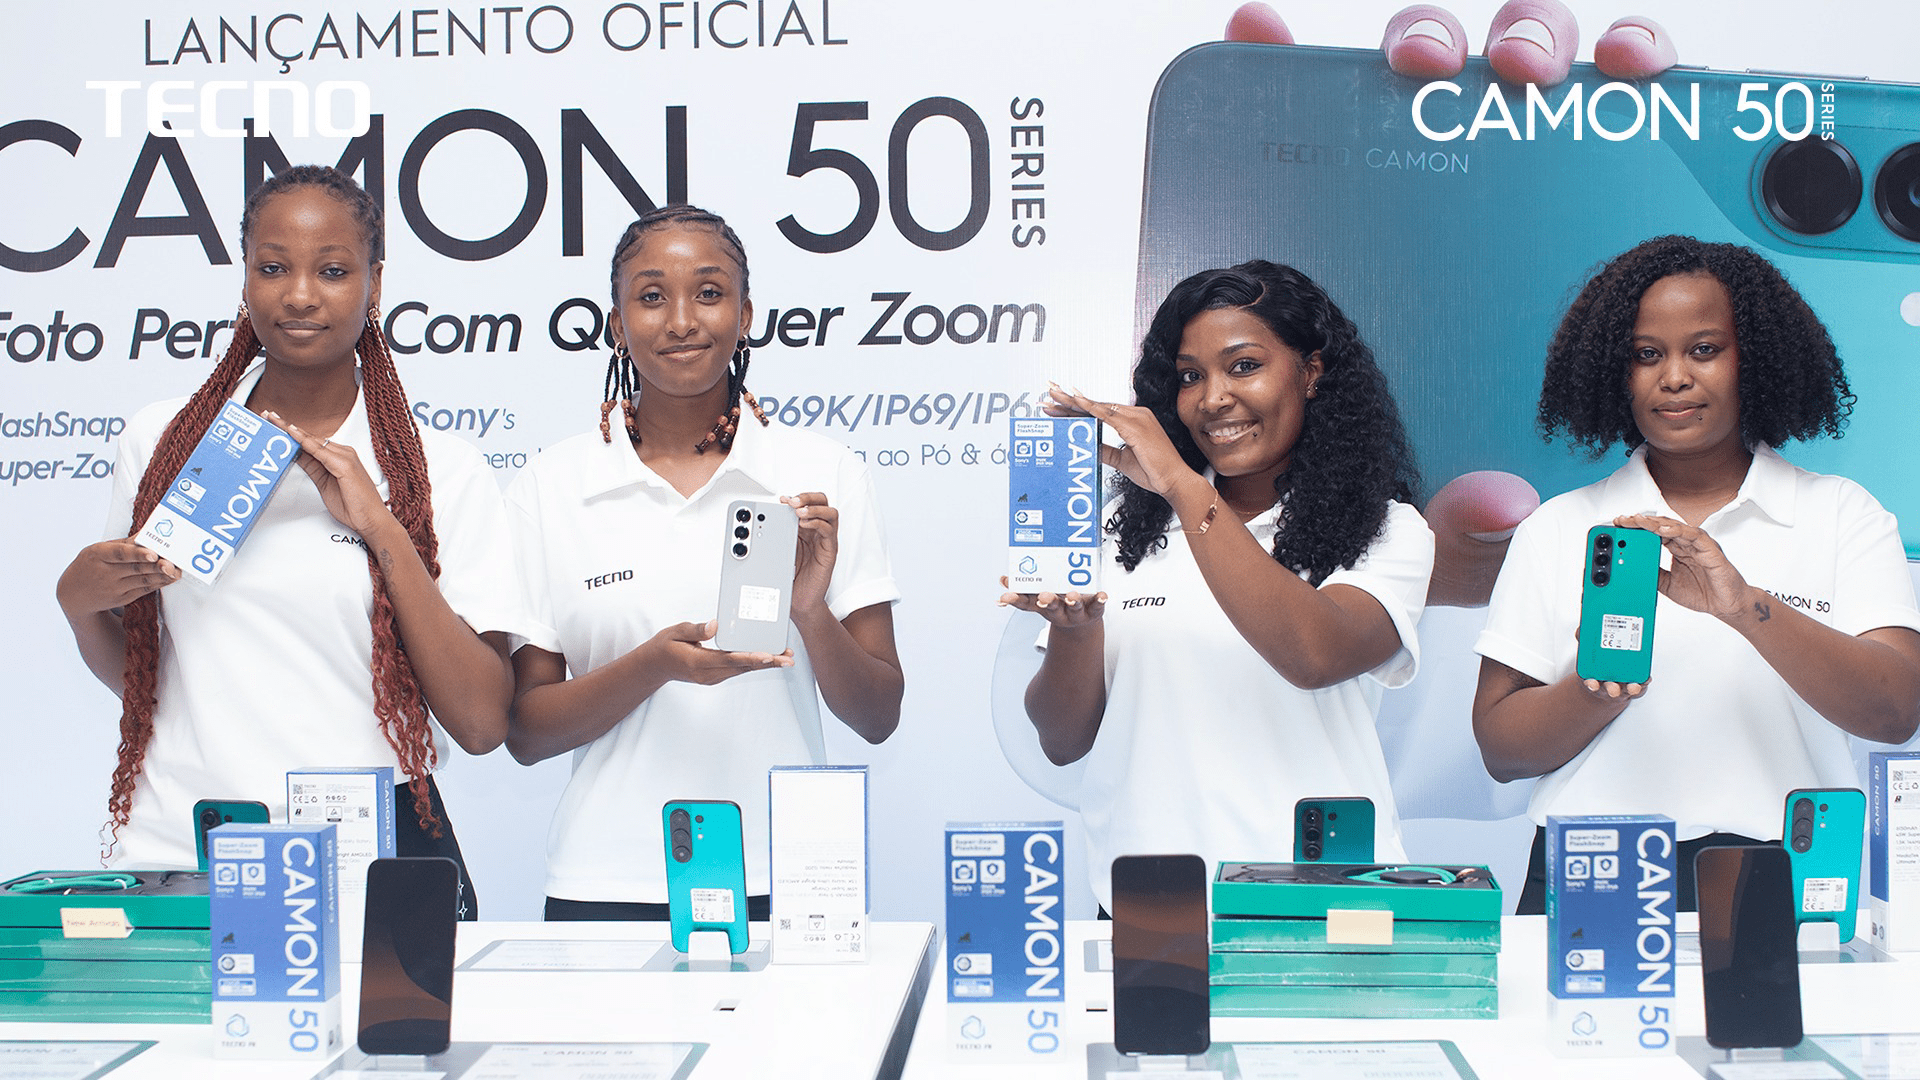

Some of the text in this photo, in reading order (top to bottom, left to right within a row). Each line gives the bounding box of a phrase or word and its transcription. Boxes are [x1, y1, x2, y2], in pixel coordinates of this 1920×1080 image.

[144, 0, 848, 74] LANÇAMENTO OFICIAL
[775, 96, 991, 254] 50
[1010, 96, 1046, 249] SERIES
[1365, 147, 1470, 174] CAMON
[385, 301, 522, 354] Com
[858, 291, 1046, 347] Zoom
[0, 410, 126, 443] lashSnap
[412, 401, 516, 438] Sony's
[877, 449, 910, 466] ao
[921, 444, 951, 466] Pó
[961, 443, 981, 465] &
[192, 435, 292, 575] CAMON 50
[1067, 420, 1093, 586] CAMON 50
[330, 534, 369, 552] CAMO
[584, 569, 634, 590] TECNO
[1122, 596, 1166, 611] TECNO
[1815, 600, 1831, 613] 50
[282, 837, 320, 1052] CAMON 50
[1023, 832, 1060, 1053] CAMON 50
[1637, 828, 1672, 1050] CAMON 50
